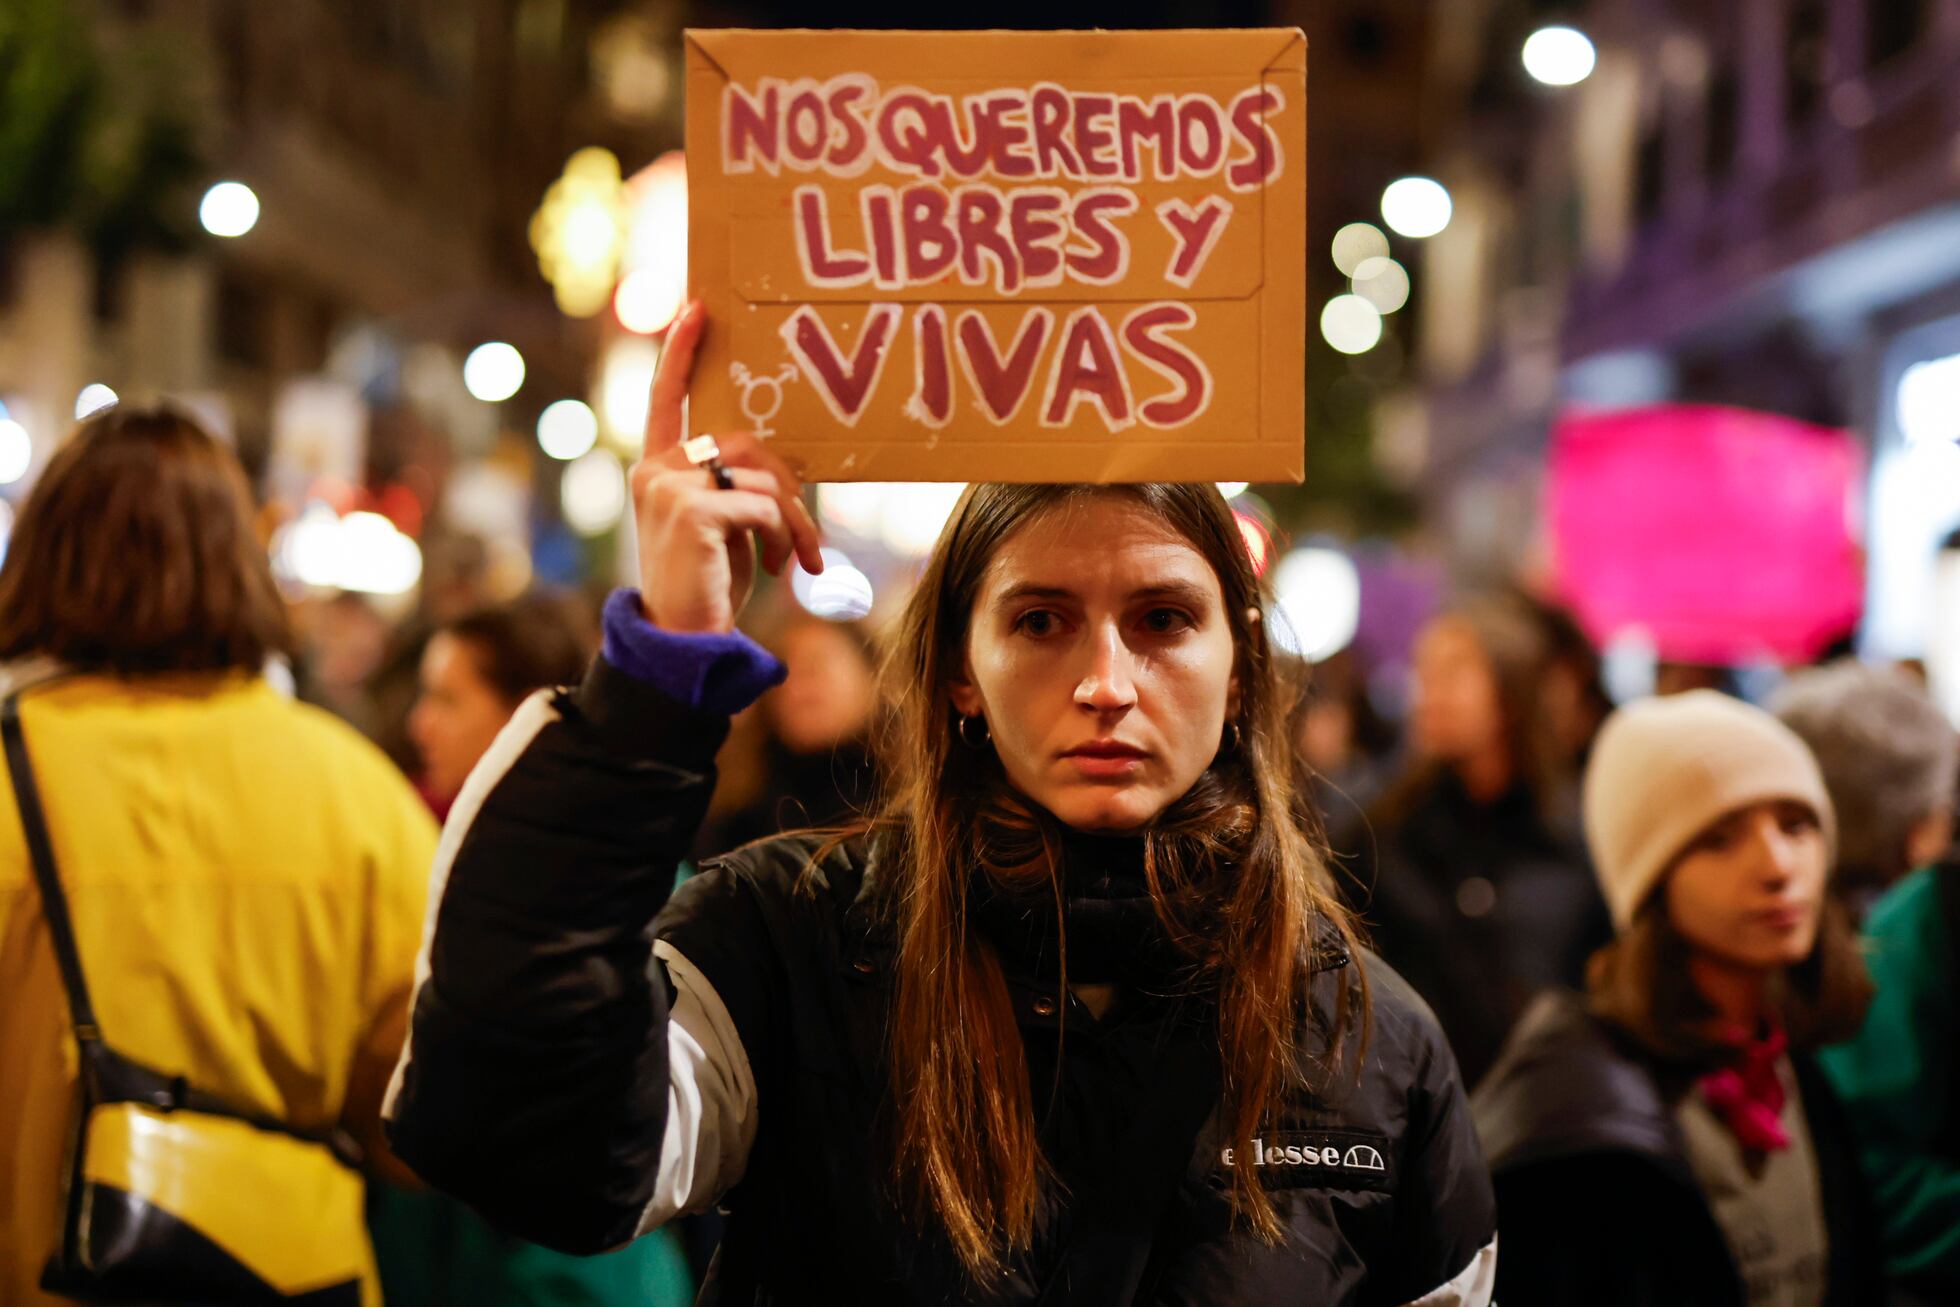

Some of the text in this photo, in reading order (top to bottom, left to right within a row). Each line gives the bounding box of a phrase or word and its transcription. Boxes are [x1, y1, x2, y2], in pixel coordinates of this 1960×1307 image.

[723, 74, 1285, 193] NOS QUEREMOS
[794, 184, 1232, 295] LIBRES Y
[779, 302, 1213, 431] VIVAS
[1221, 1138, 1340, 1166] elesse
